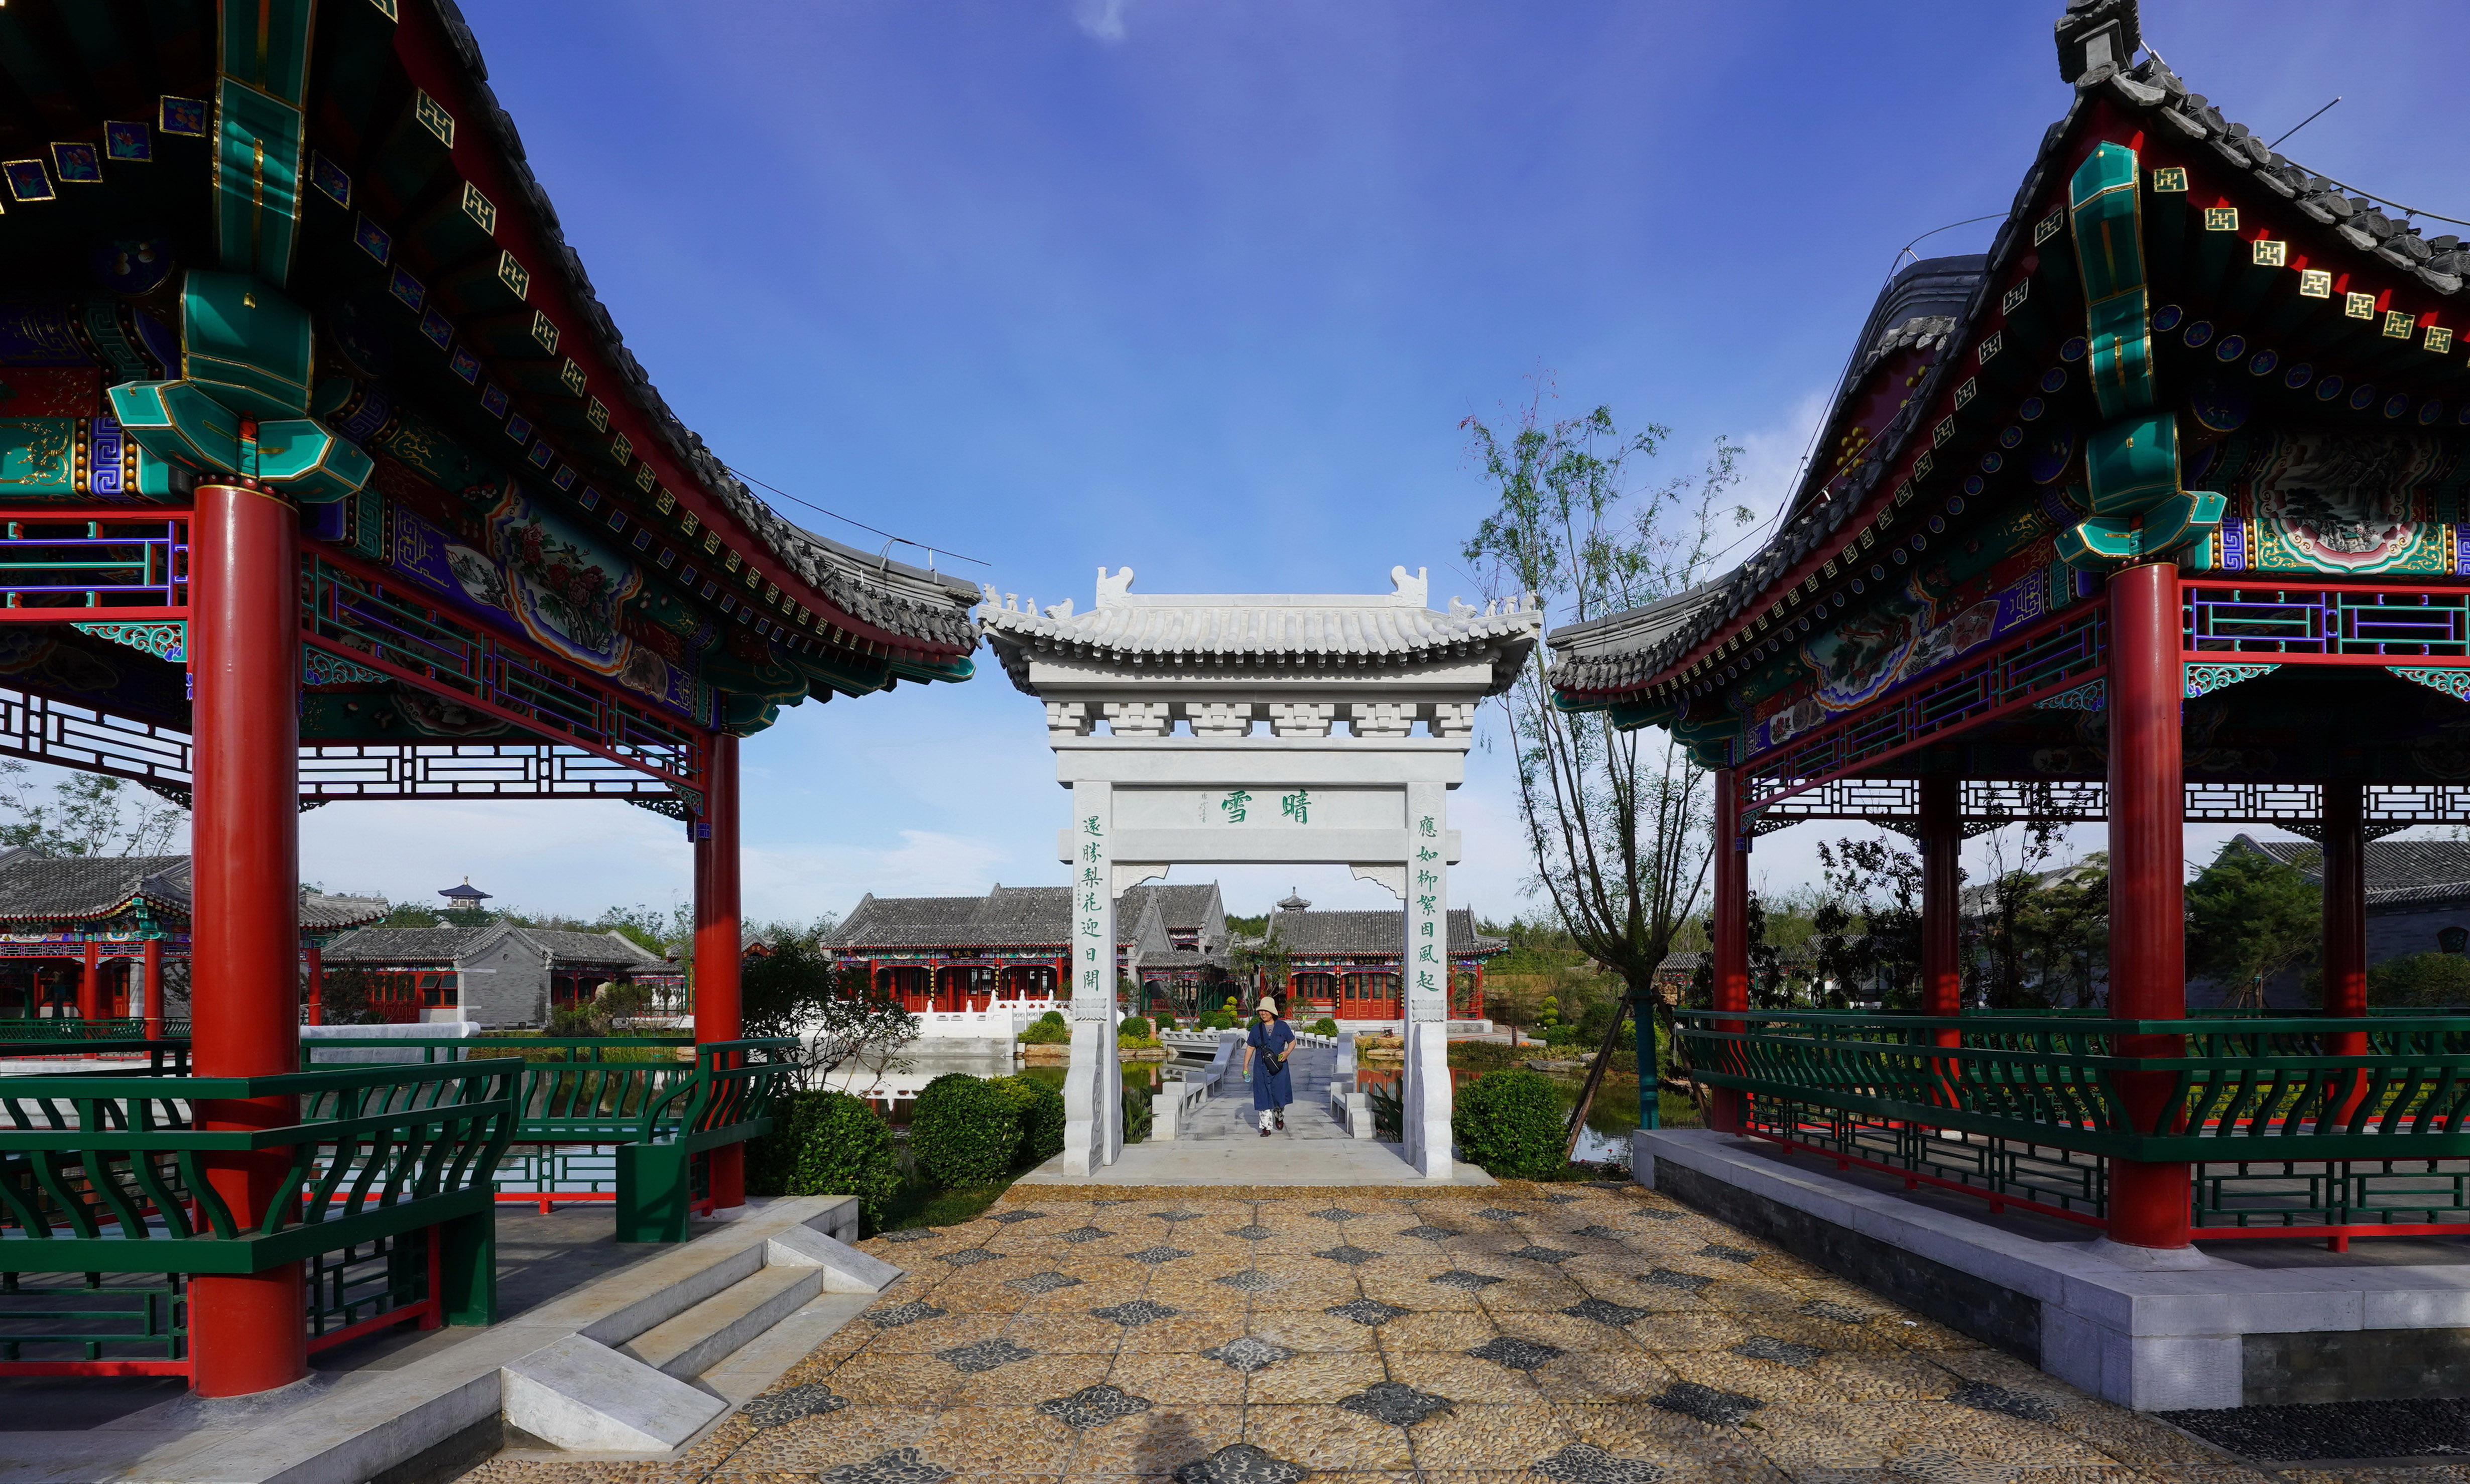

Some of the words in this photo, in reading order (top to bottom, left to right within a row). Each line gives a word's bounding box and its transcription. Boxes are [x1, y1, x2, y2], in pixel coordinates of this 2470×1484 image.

[1081, 815, 1104, 992] 還勝梨花迎日開
[1416, 816, 1439, 992] 應如柳絮因風起
